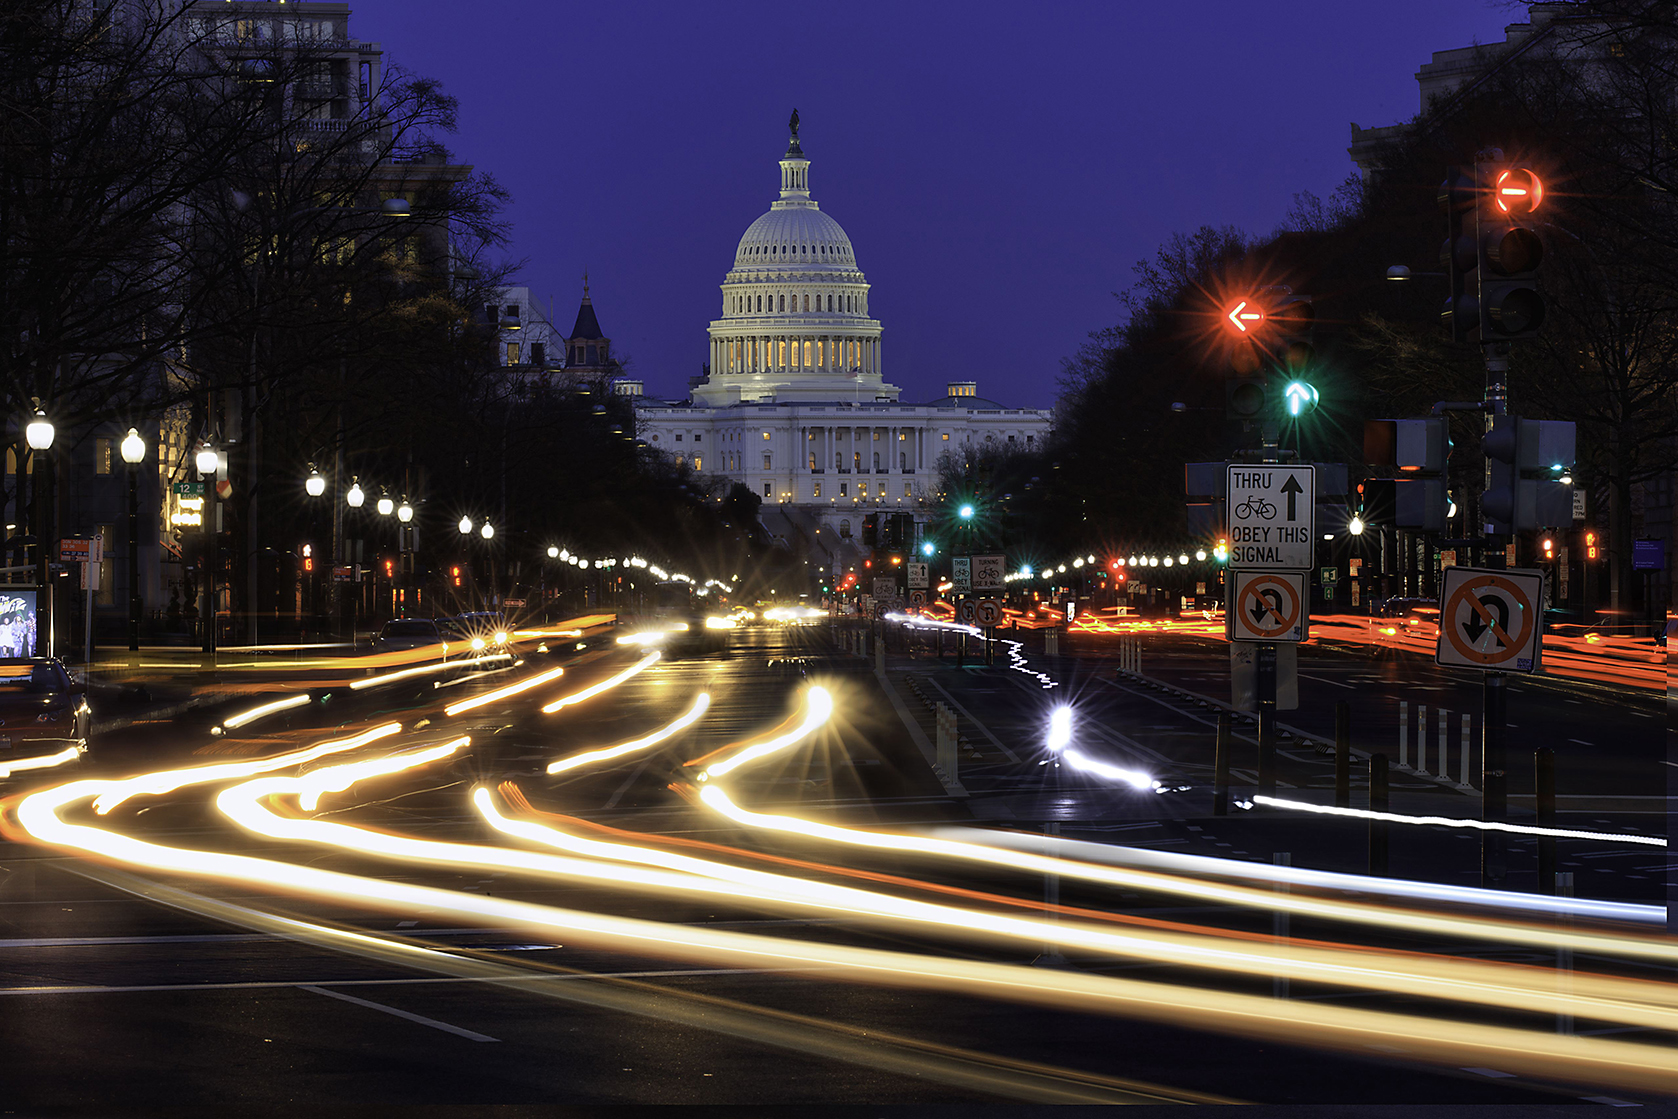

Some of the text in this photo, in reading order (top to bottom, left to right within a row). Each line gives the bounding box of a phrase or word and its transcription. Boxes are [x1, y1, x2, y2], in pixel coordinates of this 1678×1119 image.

[179, 484, 190, 493] 12
[1233, 472, 1272, 489] THRU
[1232, 526, 1308, 543] OBEY THIS
[1232, 546, 1284, 562] SIGNAL
